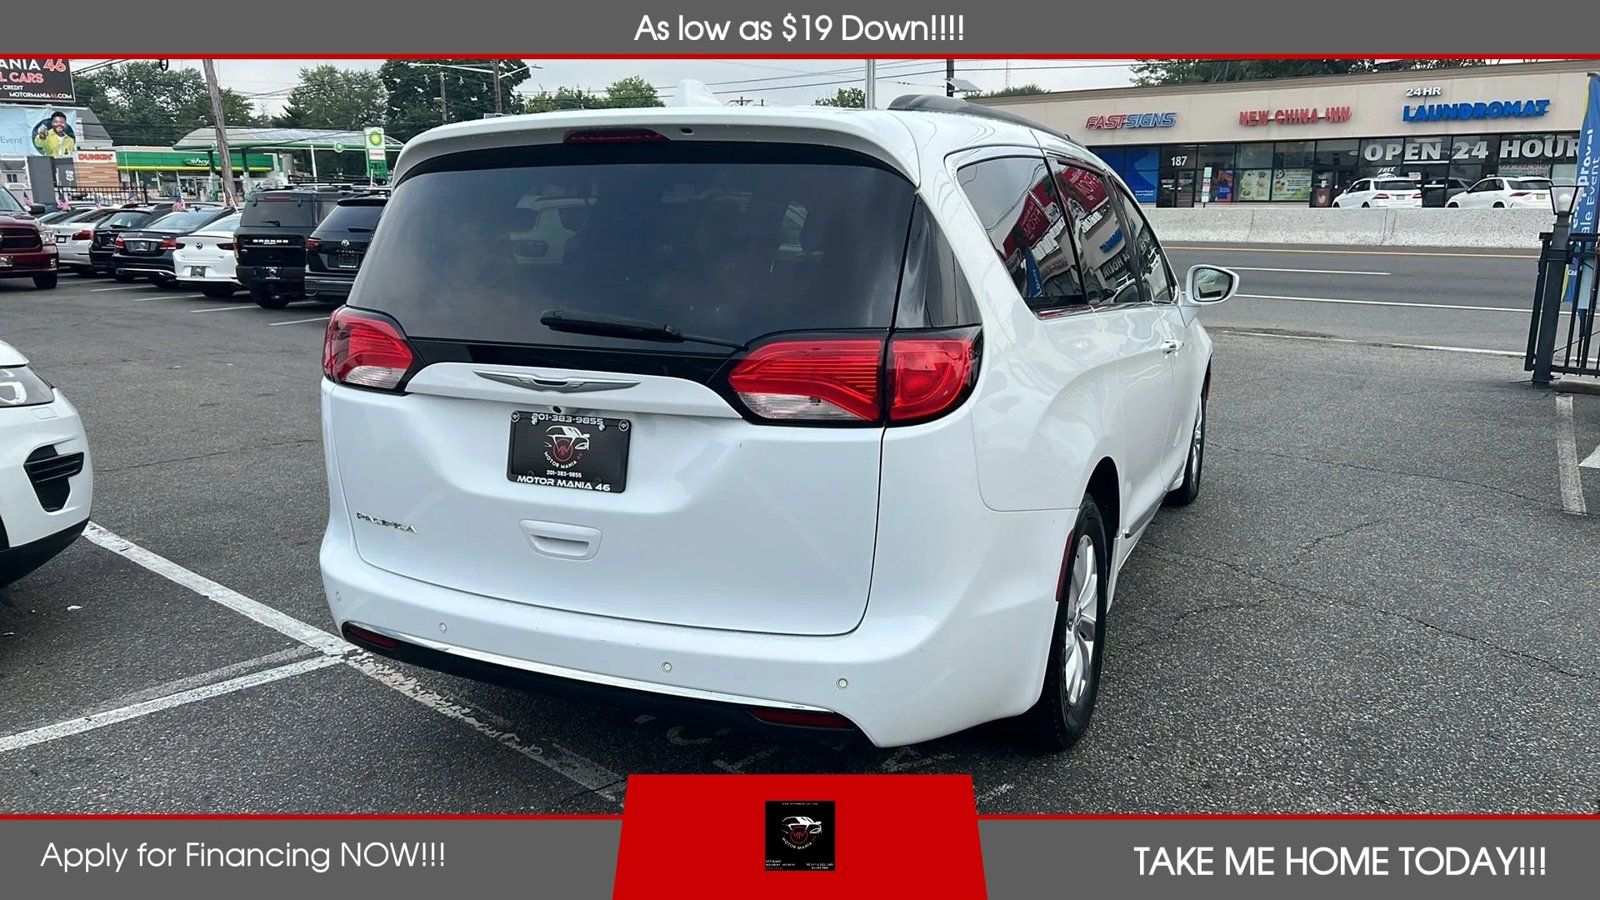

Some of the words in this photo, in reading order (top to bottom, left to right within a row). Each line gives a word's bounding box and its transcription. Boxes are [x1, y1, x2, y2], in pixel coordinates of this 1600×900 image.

[43, 59, 67, 72] 46
[9, 72, 44, 84] CARS
[1239, 110, 1269, 126] NEW
[1275, 107, 1319, 125] CHINA
[1325, 106, 1352, 123] INN
[1403, 99, 1551, 121] LAUNDROMAT
[1085, 112, 1178, 130] FASTSIGNS
[1364, 142, 1443, 161] OPEN
[1452, 141, 1490, 160] 24
[1499, 139, 1579, 159] HOUR
[1171, 156, 1188, 167] 187
[531, 413, 604, 425] 201-383-9855
[516, 474, 555, 486] MOTOR
[557, 479, 593, 490] MANIA
[594, 483, 611, 492] 46
